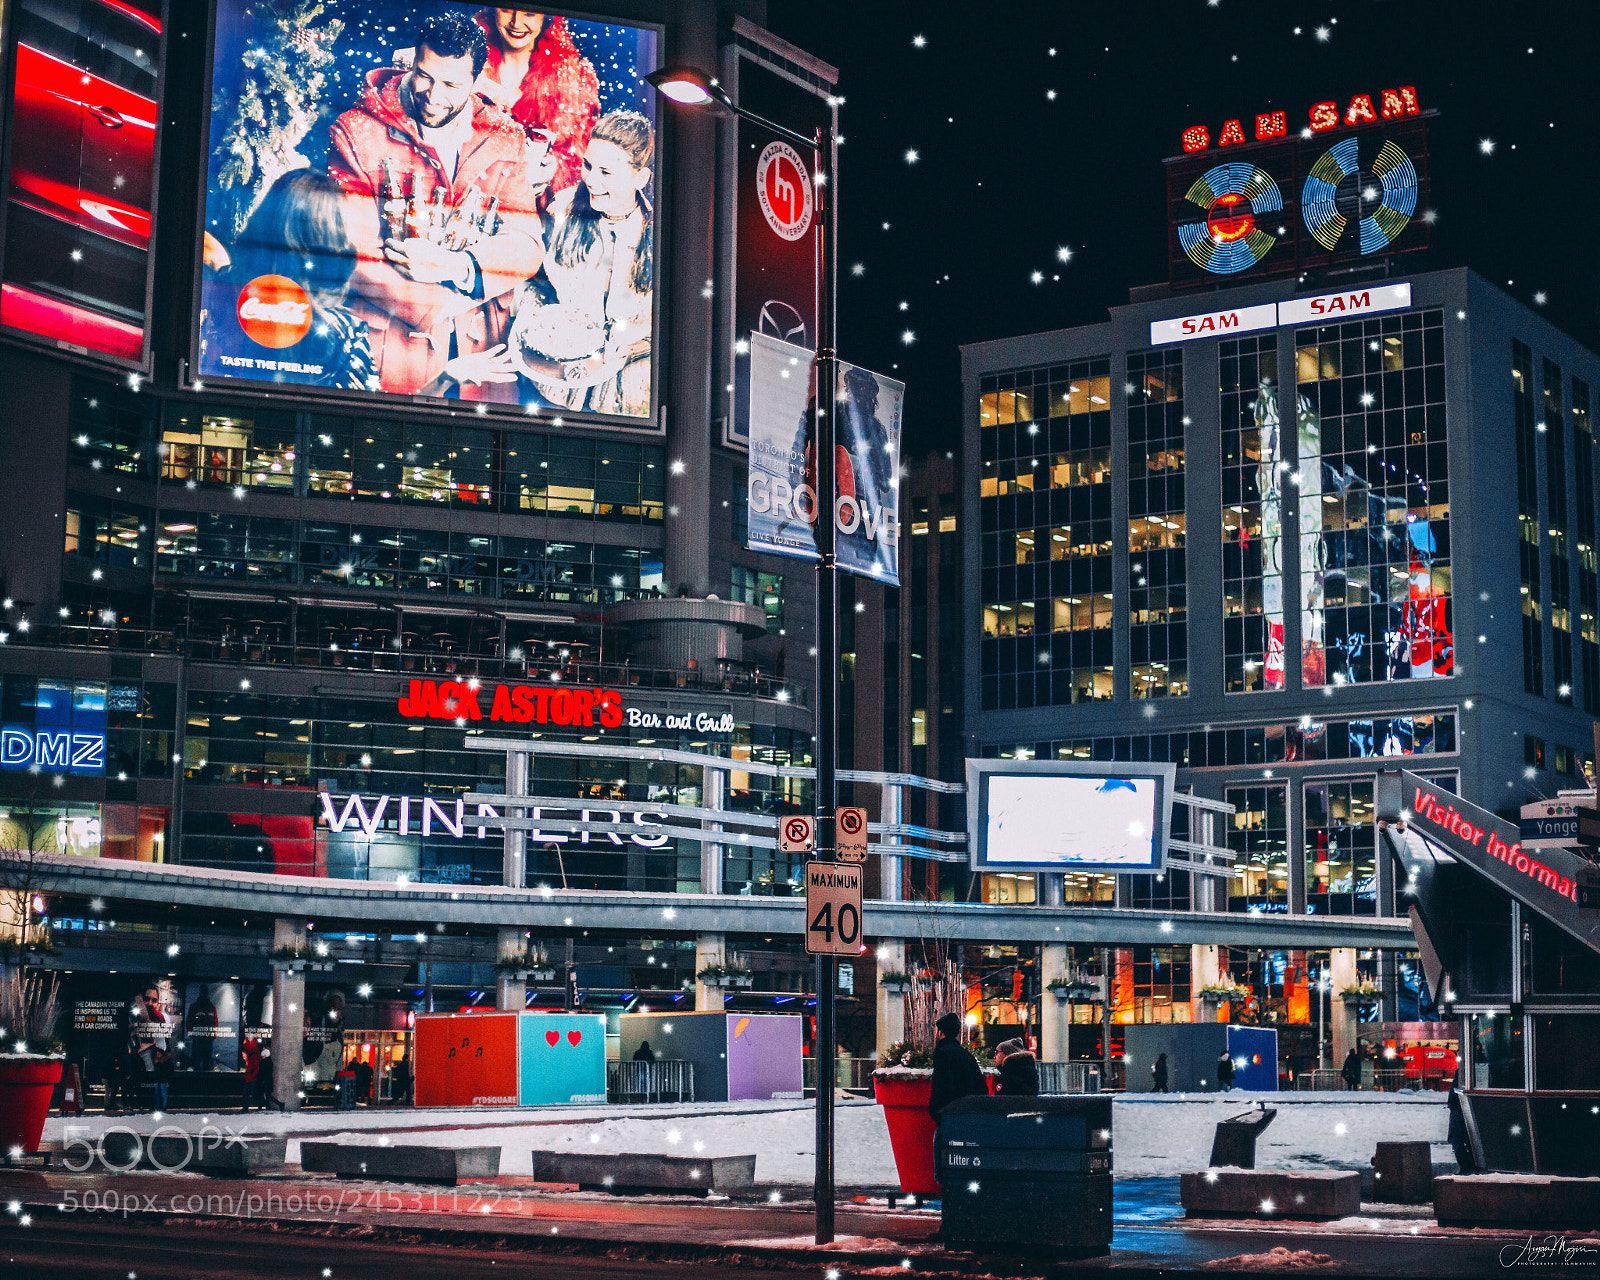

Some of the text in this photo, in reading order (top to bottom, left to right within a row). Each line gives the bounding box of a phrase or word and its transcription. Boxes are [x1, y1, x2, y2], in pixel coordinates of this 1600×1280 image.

[1309, 85, 1420, 131] SAM
[1182, 110, 1287, 152] SAM
[763, 145, 783, 163] MAZDA
[784, 147, 807, 181] CANADA
[769, 214, 809, 237] ANNIVERSARY
[1310, 291, 1371, 315] SAM
[1182, 312, 1239, 335] SAM
[220, 355, 323, 375] TASTE THE FEELING
[752, 439, 805, 463] TORONTO'S
[799, 465, 811, 478] OF
[751, 531, 801, 547] LIVE YONGE
[398, 679, 735, 733] JACK ASTOR'S Bar and Grill
[0, 730, 104, 767] DMZ
[1414, 787, 1485, 847] Visitor
[1537, 820, 1578, 837] Yonge
[811, 872, 858, 889] MAXIMUM
[810, 902, 859, 944] 40
[949, 1154, 970, 1166] Litter
